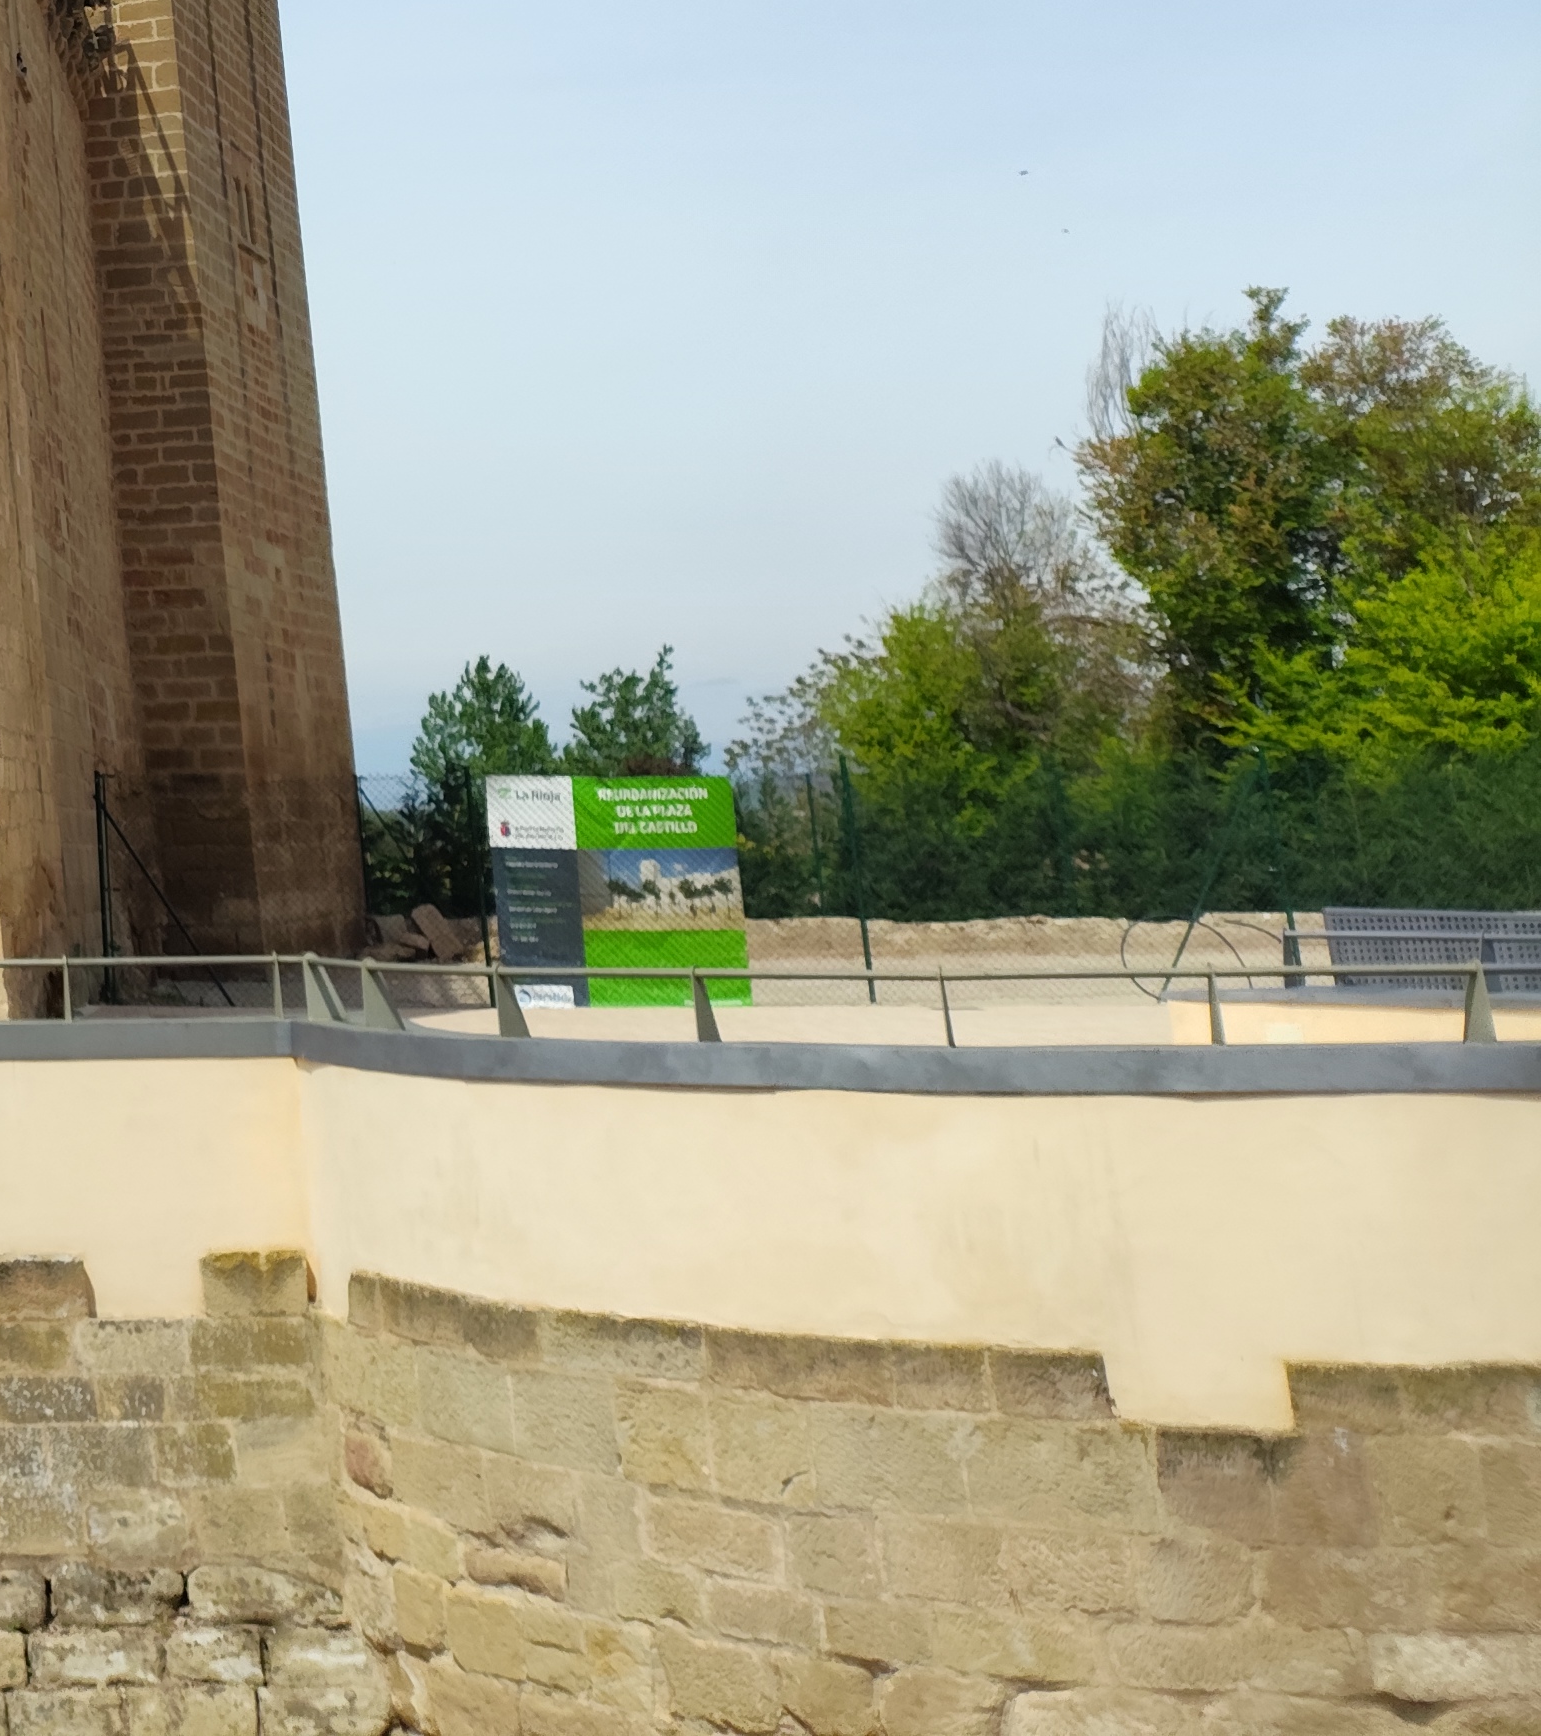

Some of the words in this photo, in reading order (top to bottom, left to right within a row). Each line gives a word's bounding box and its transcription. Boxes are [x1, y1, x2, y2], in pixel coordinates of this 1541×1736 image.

[516, 791, 529, 801] La
[531, 790, 561, 803] Rioja
[616, 804, 633, 817] DE
[636, 804, 651, 817] LA
[652, 804, 693, 817] PLAZA
[614, 821, 636, 834] DEL
[639, 820, 698, 834] CASTILLO
